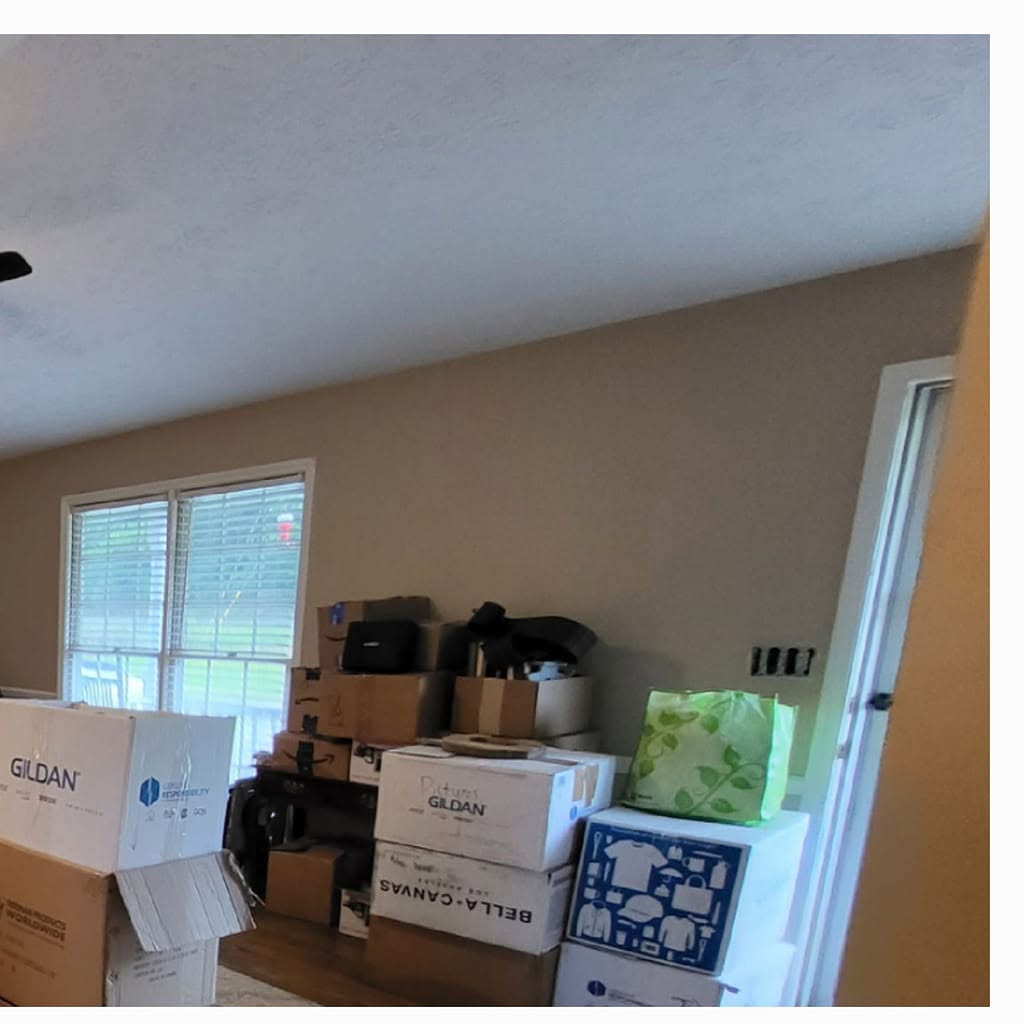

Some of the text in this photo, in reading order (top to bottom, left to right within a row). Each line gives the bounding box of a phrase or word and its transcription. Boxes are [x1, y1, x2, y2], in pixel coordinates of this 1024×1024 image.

[10, 757, 78, 792] GILDAN
[428, 795, 487, 817] GILDAN
[6, 910, 66, 942] WORLDWIDE
